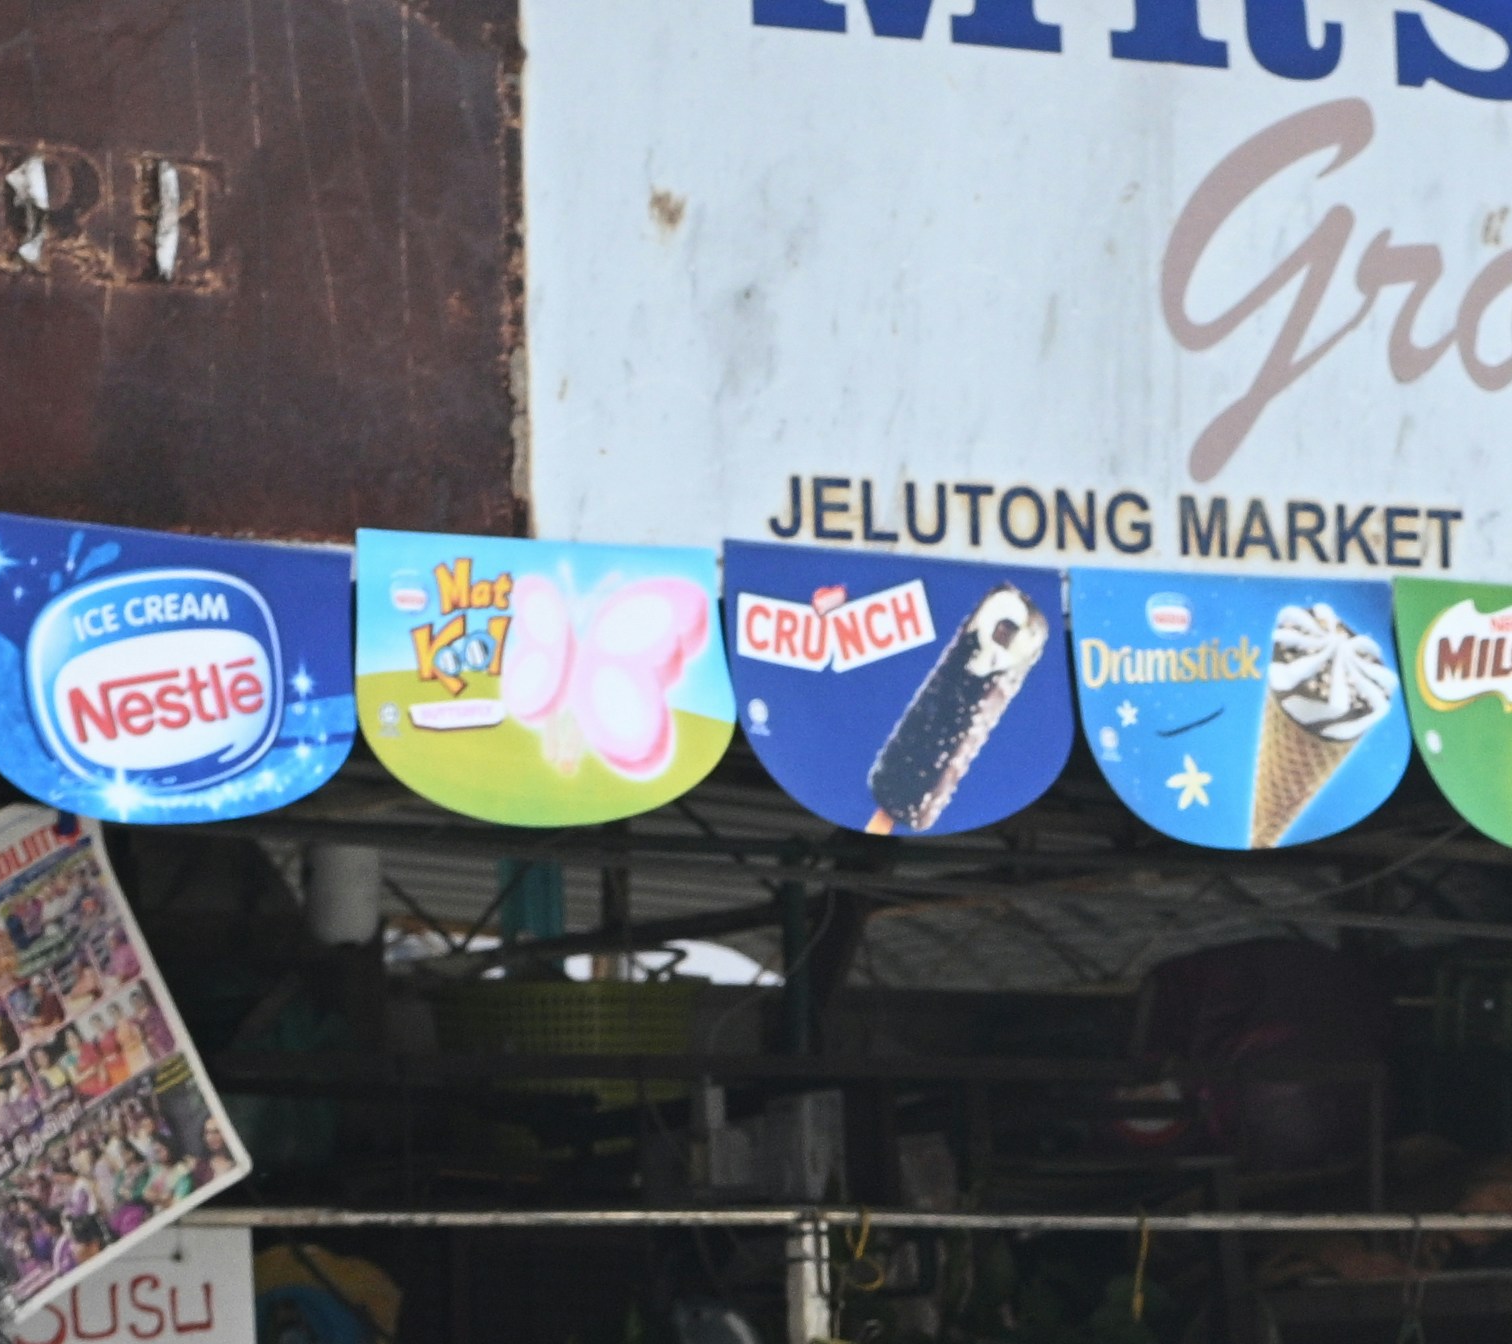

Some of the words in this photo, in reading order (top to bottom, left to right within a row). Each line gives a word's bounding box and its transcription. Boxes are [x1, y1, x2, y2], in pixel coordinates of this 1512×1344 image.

[768, 474, 1153, 555] JELUTONG
[1178, 495, 1463, 570] MARKET
[435, 558, 512, 615] Mat
[72, 605, 119, 643] ICE
[124, 592, 229, 626] CREAM
[744, 598, 924, 663] CRUNCH
[1081, 635, 1262, 688] Drumstick
